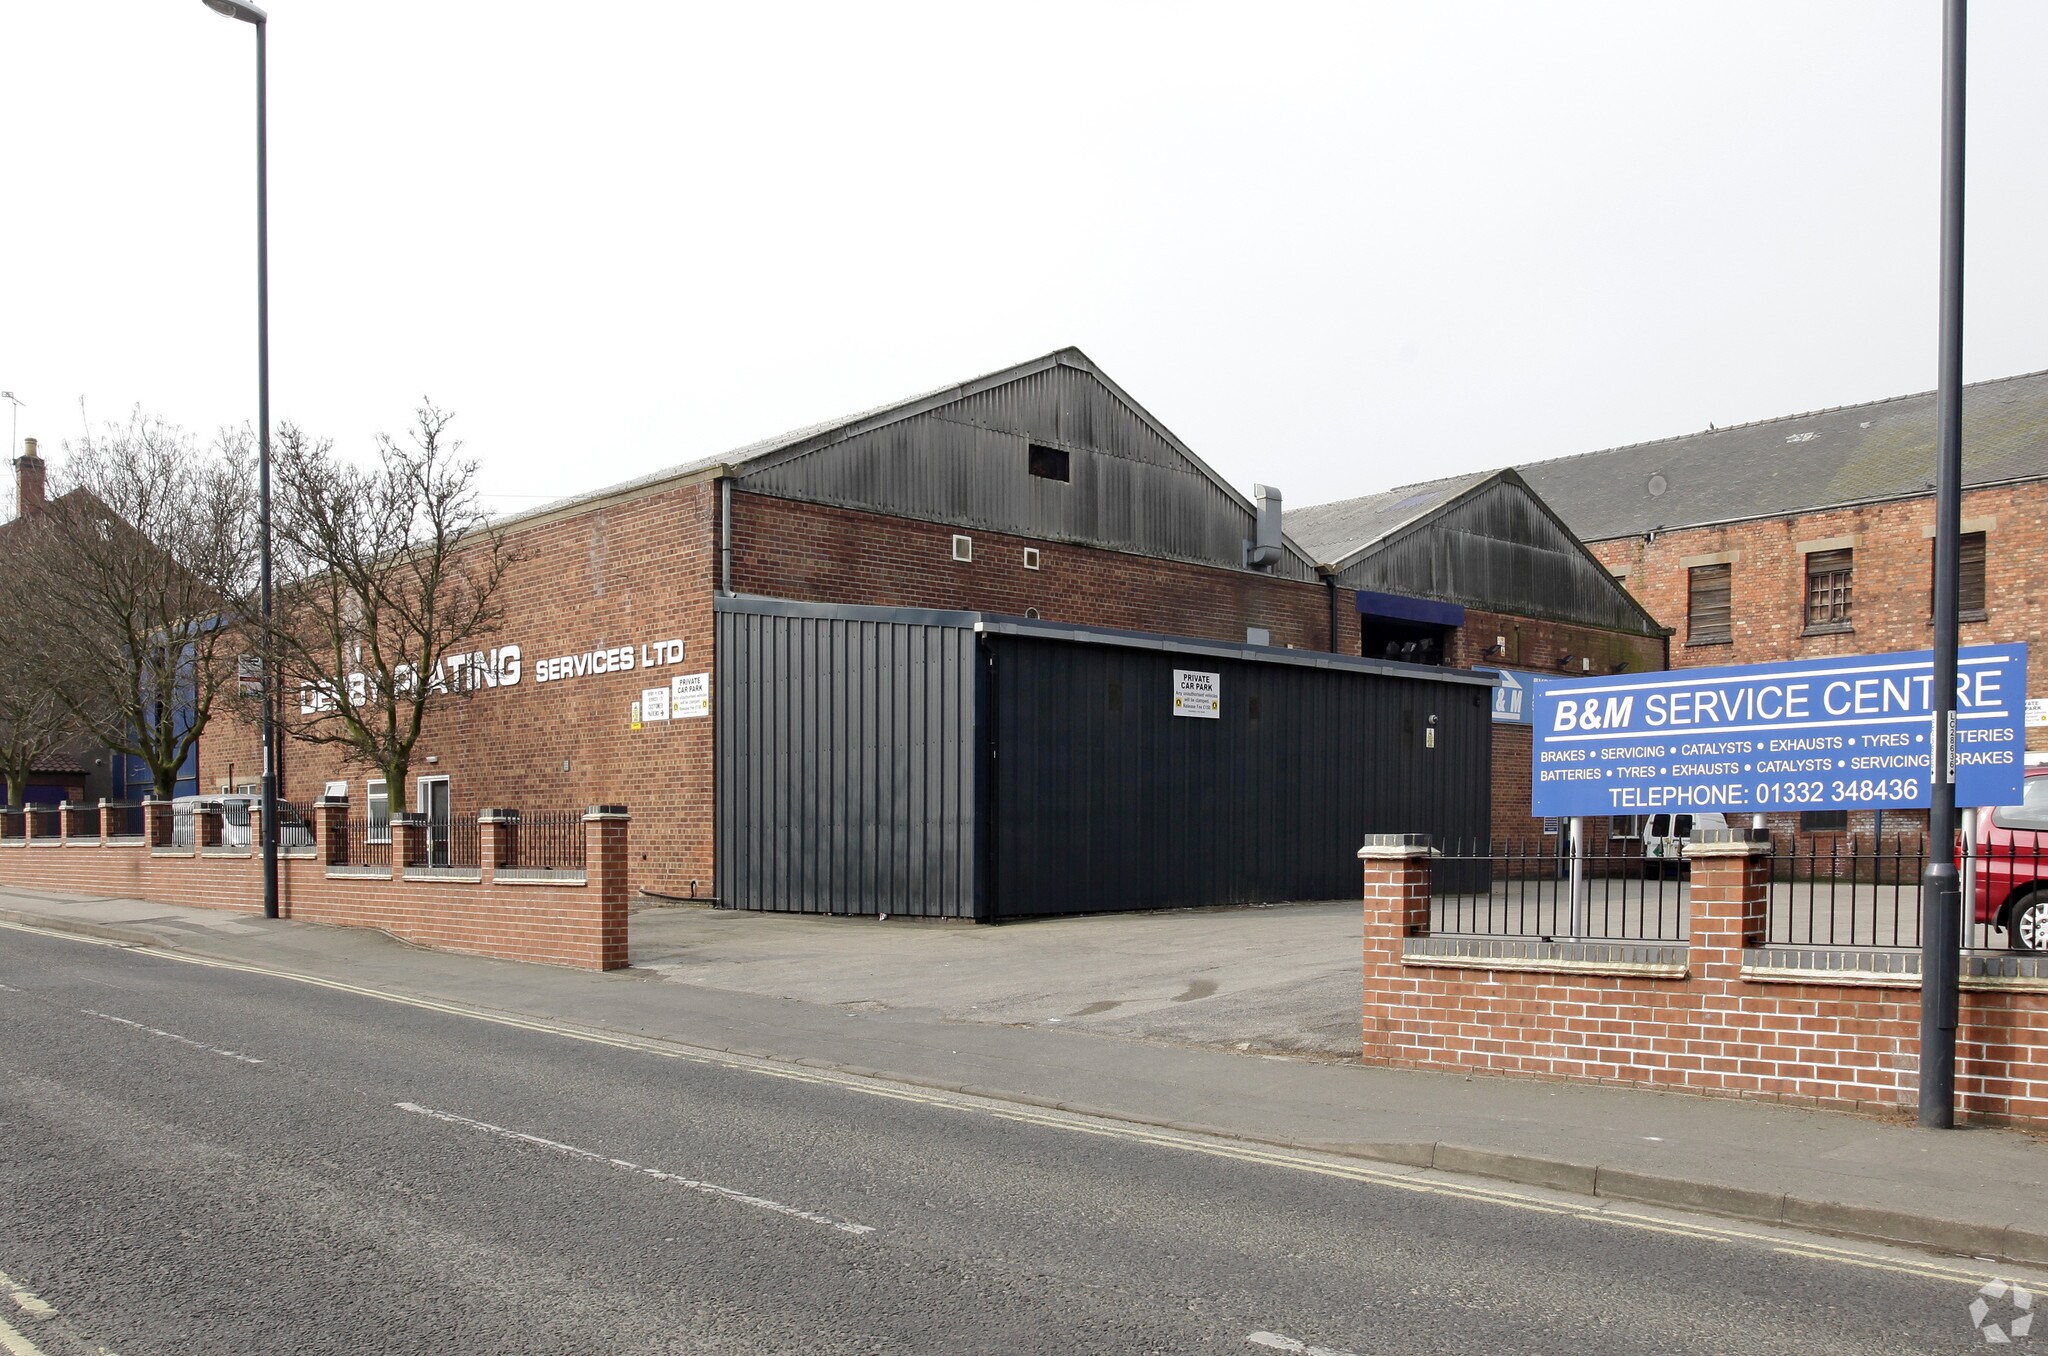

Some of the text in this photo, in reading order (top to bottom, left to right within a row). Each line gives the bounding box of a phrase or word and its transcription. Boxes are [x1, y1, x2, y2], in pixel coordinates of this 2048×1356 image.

[536, 646, 635, 683] SERVICES
[642, 639, 684, 667] LTD
[678, 686, 688, 694] CAR
[680, 677, 701, 685] PRIVATE
[1181, 682, 1194, 690] CAR
[1184, 674, 1210, 683] PRIVATE
[1553, 670, 2002, 732] B&M SERVICE CENTRE
[1541, 750, 1586, 763] BRAKES
[1601, 745, 1665, 760] SERVICING
[1681, 741, 1752, 756] CATALYSTS
[1770, 737, 1843, 752] EXHAUSTS
[1862, 733, 1910, 747] TYRES
[1541, 768, 1601, 781] BATTERIES
[1617, 766, 1656, 778] TYRES
[1672, 762, 1739, 776] EXHAUSTS
[1756, 758, 1832, 772] CATALYSTS
[1851, 754, 1930, 769] SERVICING
[1609, 778, 1918, 807] TELEPHONE: 01332 348436
